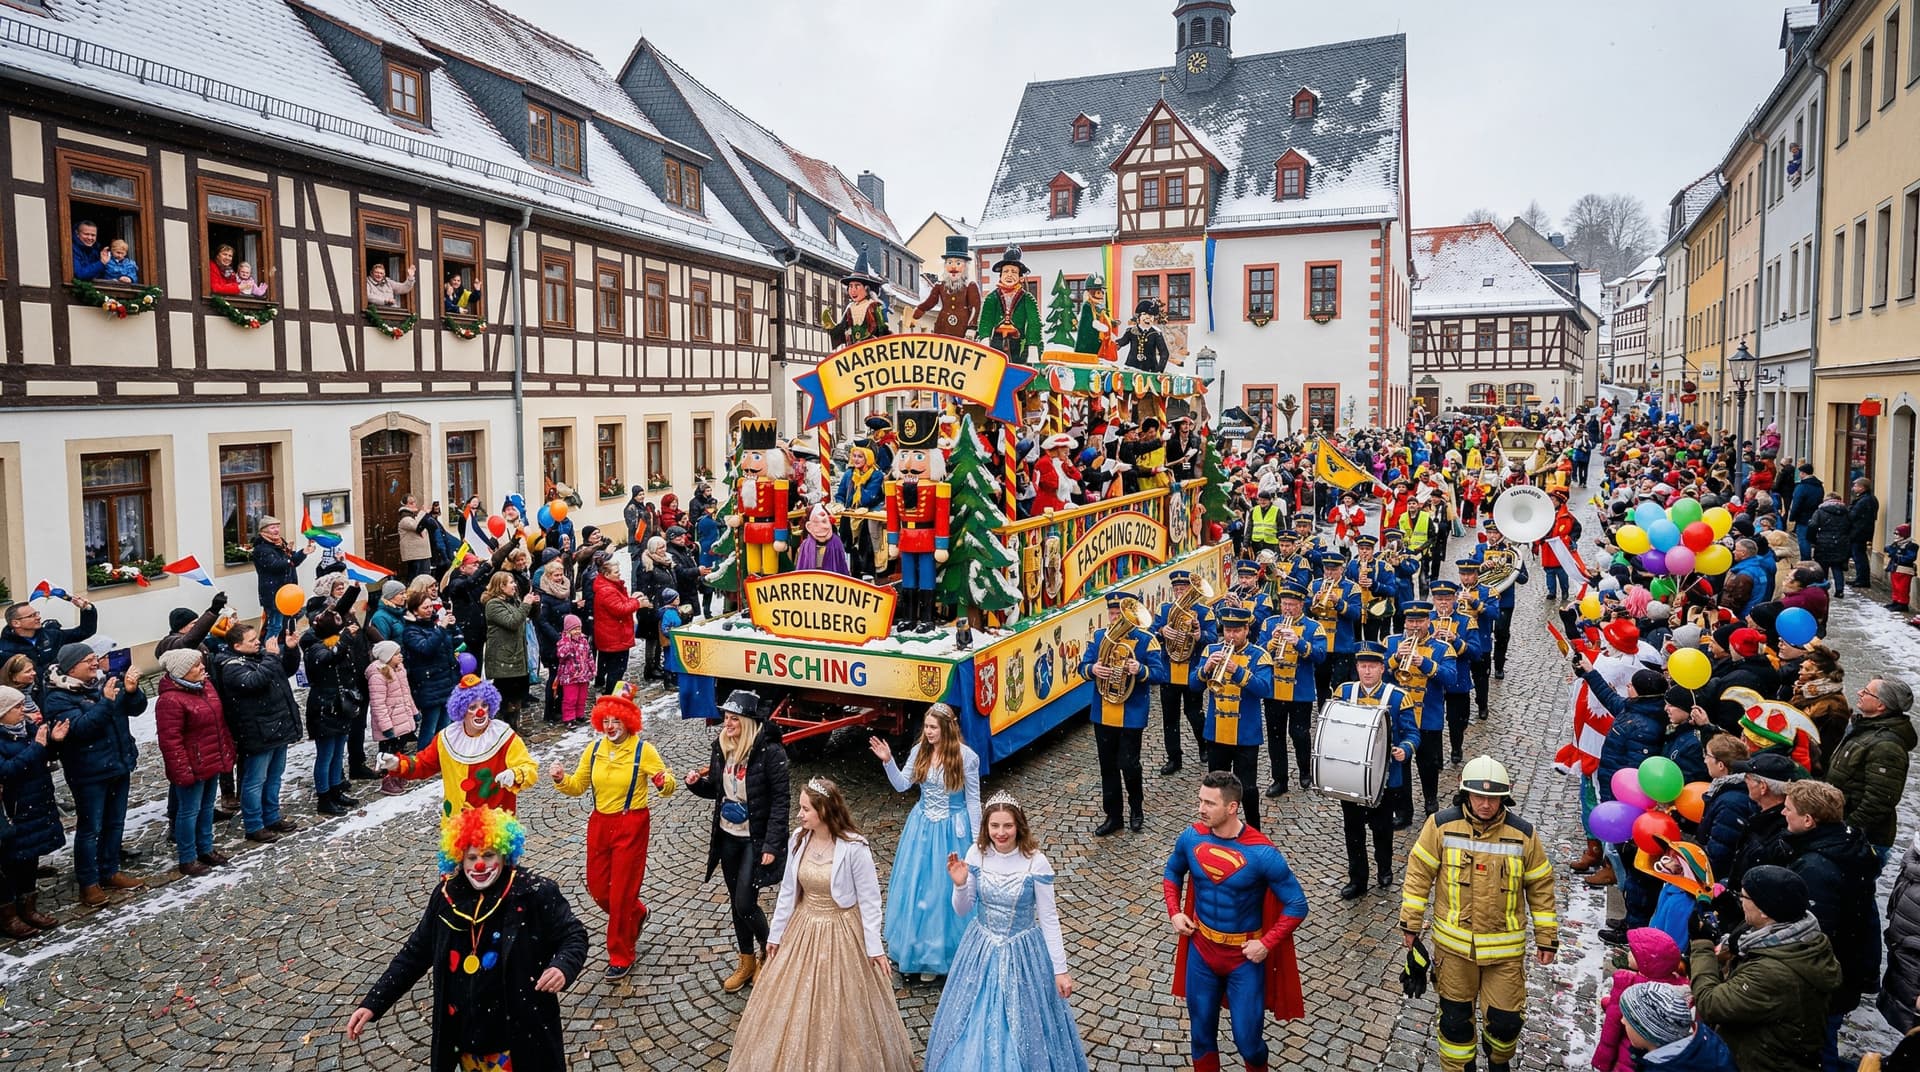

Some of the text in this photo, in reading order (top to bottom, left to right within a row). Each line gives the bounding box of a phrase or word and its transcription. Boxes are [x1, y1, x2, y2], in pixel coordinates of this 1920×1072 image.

[835, 340, 987, 377] NARRENZUNFT
[854, 365, 966, 393] STOLLBERG
[1077, 521, 1156, 577] FASCHING 2023
[756, 582, 883, 614] NARRENZUNFT
[772, 608, 866, 635] STOLLBERG
[744, 649, 868, 687] FASCHING
